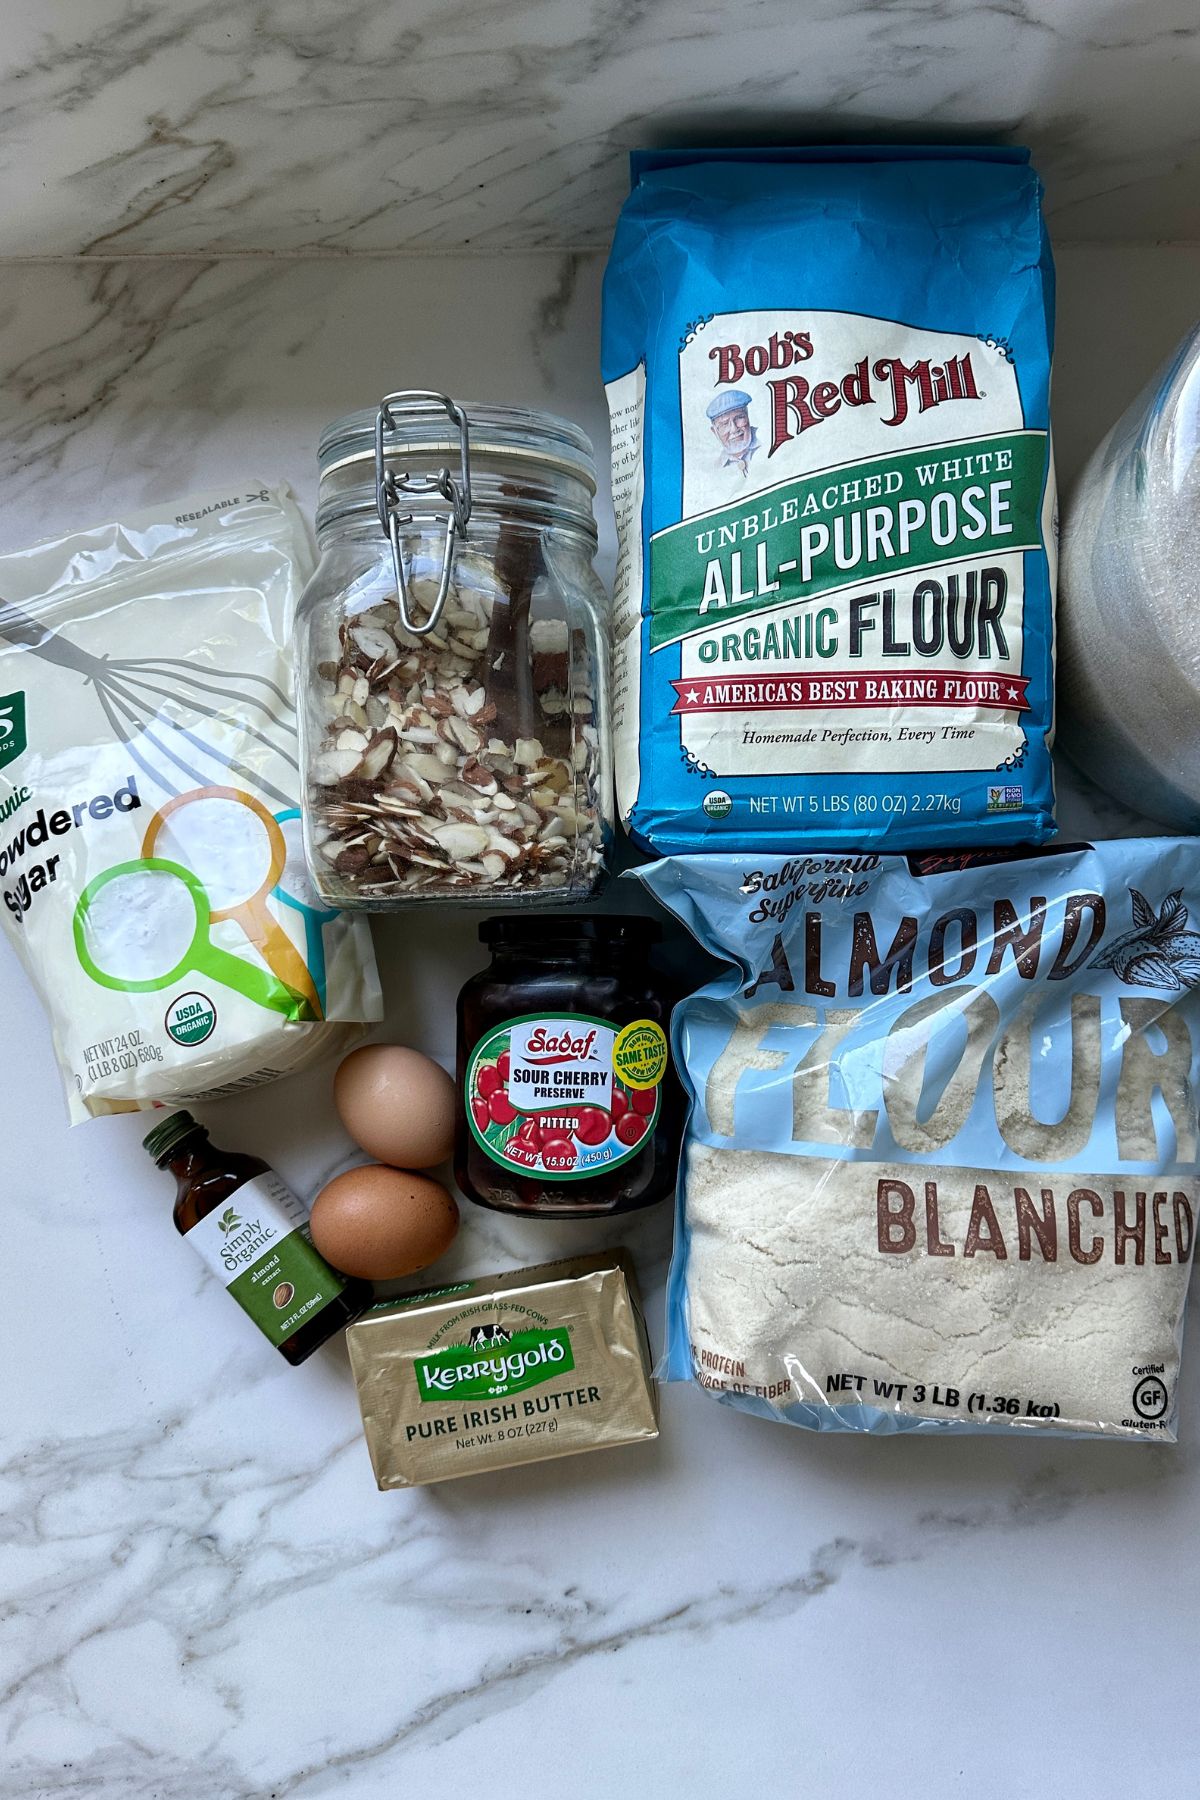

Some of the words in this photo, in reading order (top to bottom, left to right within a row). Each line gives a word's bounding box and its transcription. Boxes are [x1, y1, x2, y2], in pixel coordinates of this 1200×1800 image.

[709, 330, 814, 387] Bob's
[766, 356, 876, 458] Red
[873, 352, 981, 426] Mill
[175, 497, 240, 524] RESEALABLE
[694, 470, 904, 555] UNBLEACHED
[914, 449, 1013, 486] WHITE
[698, 480, 1014, 616] ALL-PURPOSE
[698, 607, 839, 664] ORGANIC
[849, 566, 1011, 661] FLOUR
[702, 681, 802, 705] AMERICA'S
[808, 681, 858, 702] BEST
[865, 680, 938, 701] BAKING
[943, 680, 1001, 701] FLOUR
[742, 730, 817, 745] Homemade
[821, 729, 892, 744] Perfection,
[897, 728, 936, 744] Every
[940, 727, 975, 741] Time
[750, 796, 780, 813] NET
[782, 796, 804, 813] WT
[809, 796, 818, 812] 5
[823, 796, 850, 813] LBS
[854, 794, 877, 815] (80
[881, 794, 907, 815] OZ)
[911, 795, 961, 815] 2.27kg
[743, 854, 882, 895] California
[748, 877, 871, 924] Superfine
[744, 894, 1107, 999] ALMOND
[175, 1016, 210, 1036] ORGANIC
[176, 1002, 203, 1021] USDA
[83, 1045, 101, 1064] NET
[98, 1039, 115, 1058] WT
[116, 1034, 129, 1053] 24
[128, 1030, 144, 1048] OZ
[527, 1028, 596, 1060] Sadaf
[616, 1050, 642, 1066] SAME
[643, 1043, 666, 1060] TASTE
[98, 1061, 112, 1081] LB
[112, 1058, 120, 1076] 8
[120, 1051, 138, 1073] OZ)
[139, 1046, 164, 1067] 680g
[513, 1069, 549, 1085] SOUR
[553, 1071, 609, 1086] CHERRY
[705, 983, 1198, 1164] FLOUR
[534, 1087, 585, 1099] PRESERVE
[539, 1116, 579, 1129] PITTED
[504, 1144, 524, 1160] NET
[876, 1179, 1196, 1266] BLANCHED
[220, 1219, 262, 1260] Simply
[250, 1254, 280, 1283] almond
[261, 1267, 282, 1286] extract
[427, 1333, 443, 1349] MILK
[439, 1316, 460, 1335] FROM
[460, 1305, 481, 1321] IRISH
[481, 1302, 526, 1314] GRASS-FED
[525, 1307, 549, 1325] COWS
[701, 1349, 745, 1377] PROTEIN
[1132, 1362, 1165, 1375] Certified
[755, 1379, 791, 1400] FIBER
[826, 1373, 867, 1394] NET
[874, 1379, 908, 1401] WT
[913, 1384, 926, 1403] 3
[931, 1386, 960, 1408] LB
[967, 1393, 1020, 1417] (1.36
[1026, 1398, 1060, 1420] kg)
[1140, 1390, 1161, 1406] GF
[406, 1416, 458, 1441] PURE
[463, 1403, 518, 1430] IRISH
[523, 1386, 601, 1418] BUTTER
[456, 1437, 475, 1450] Net
[476, 1434, 496, 1447] Wt.
[498, 1430, 505, 1442] 8
[507, 1427, 524, 1439] OZ
